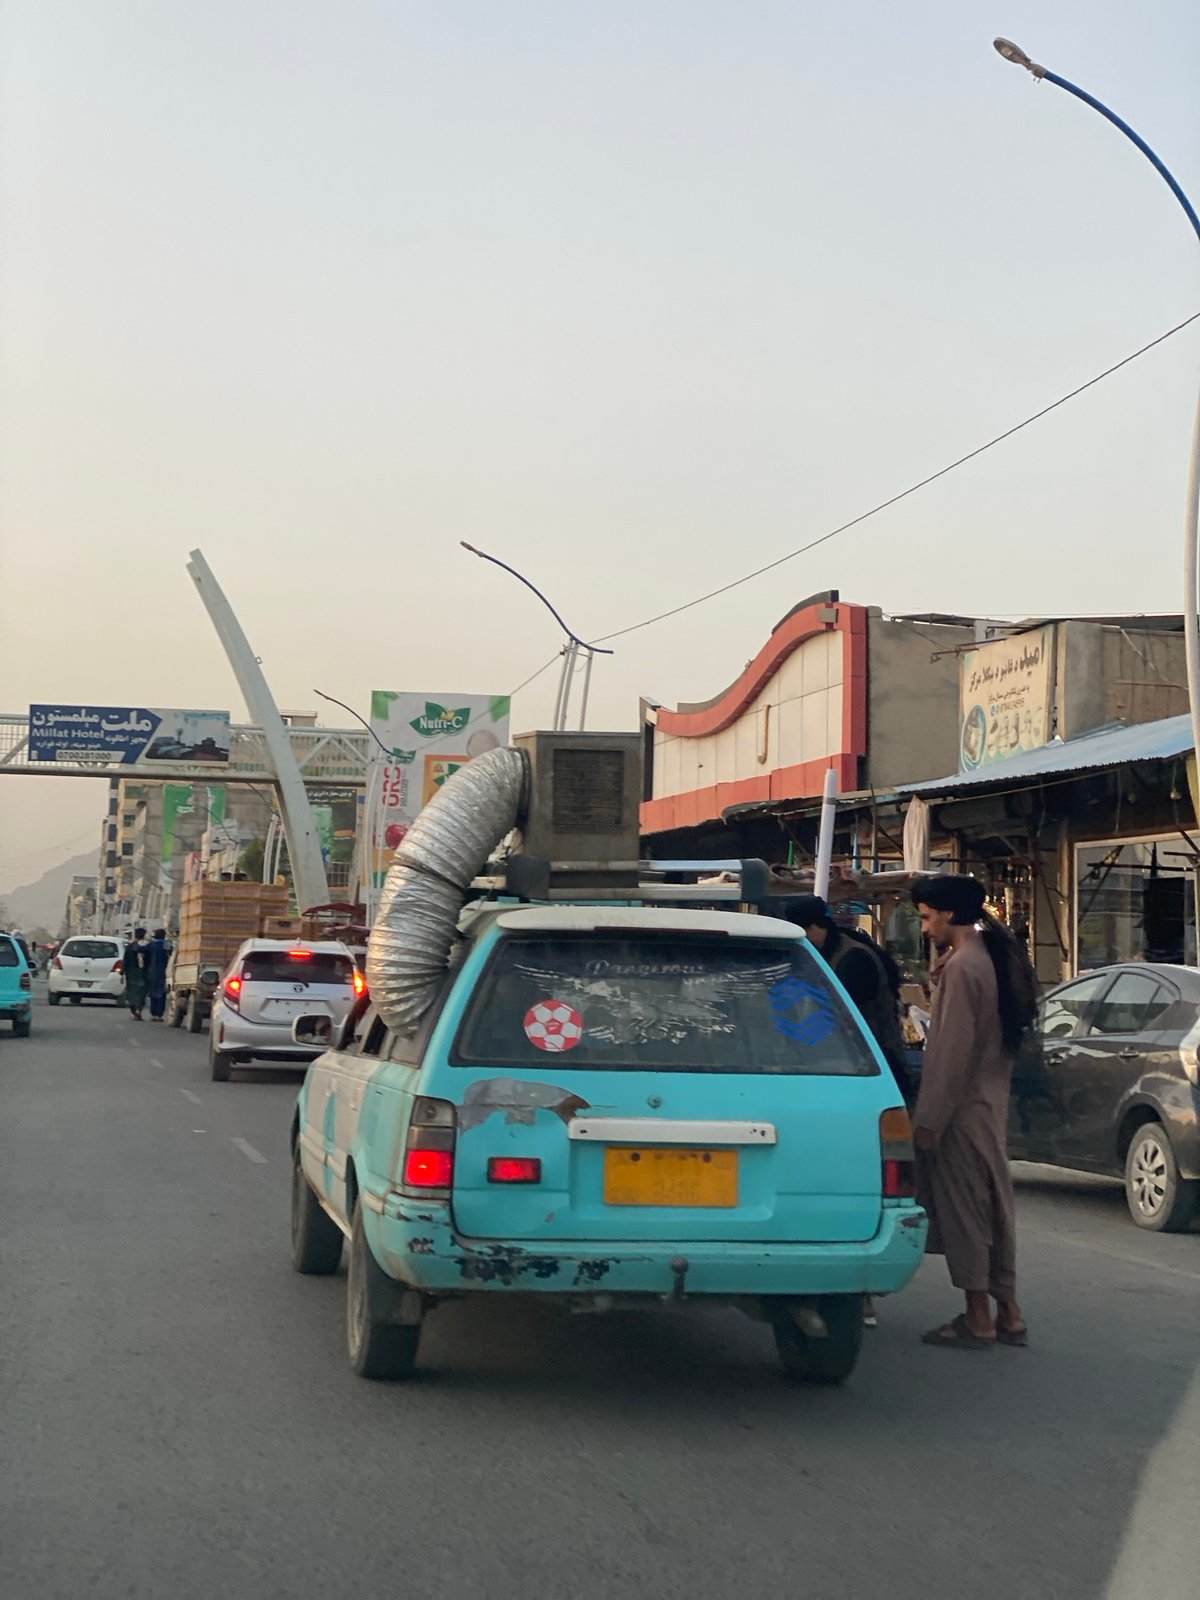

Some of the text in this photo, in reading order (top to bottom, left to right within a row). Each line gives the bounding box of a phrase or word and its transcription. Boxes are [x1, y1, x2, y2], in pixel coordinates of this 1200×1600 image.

[101, 710, 153, 732] ملت
[420, 715, 464, 729] Nutri-C
[31, 728, 105, 739] Millat Hotel
